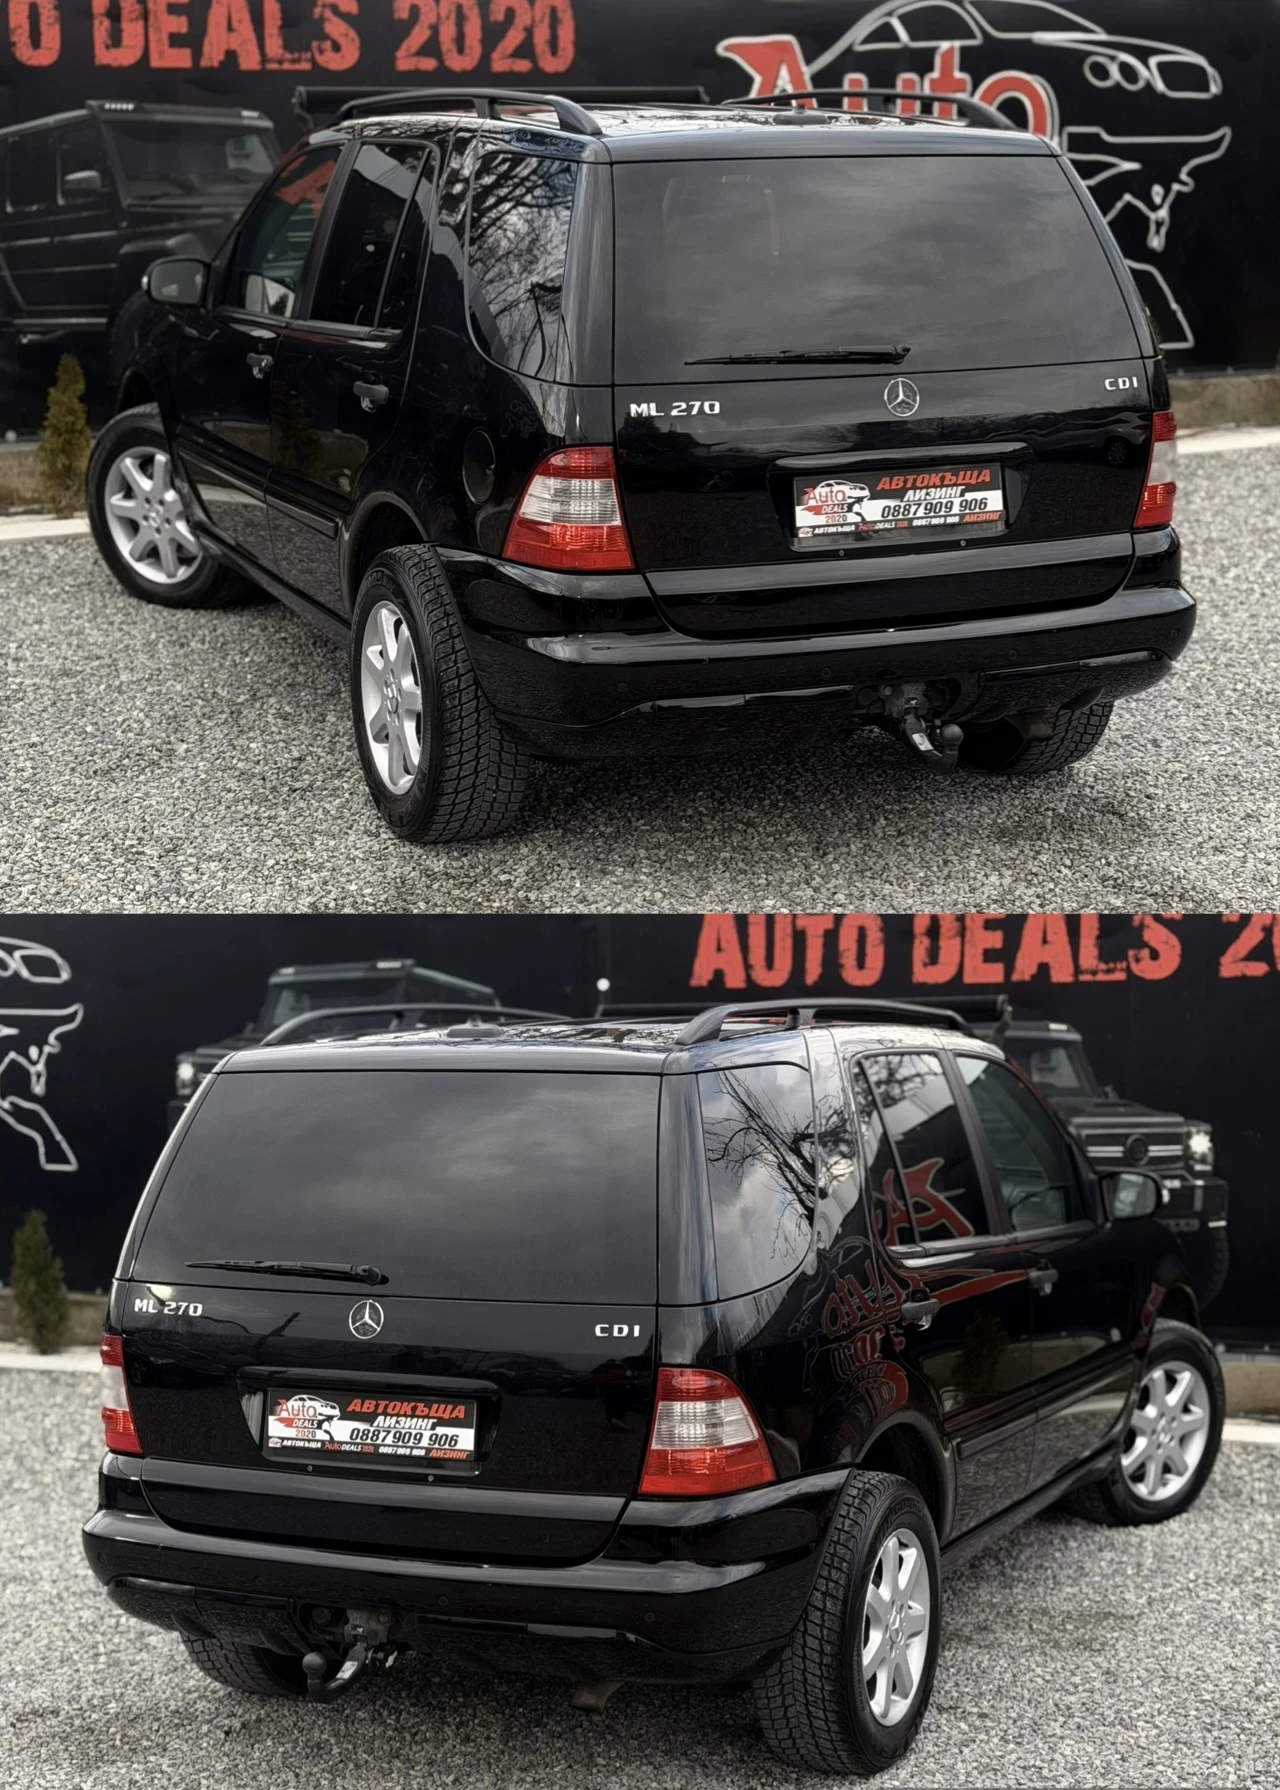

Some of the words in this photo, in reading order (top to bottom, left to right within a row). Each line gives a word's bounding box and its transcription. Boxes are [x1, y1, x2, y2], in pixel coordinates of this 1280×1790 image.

[95, 0, 361, 71] DEALS
[394, 0, 576, 74] 2020
[1104, 376, 1138, 390] CDI
[630, 402, 665, 418] ML
[670, 400, 720, 416] 270
[875, 468, 991, 491] АВТОКЪЩА
[803, 487, 848, 504] Auto
[902, 486, 966, 502] ЛИЗИНГ
[821, 504, 848, 513] DEALS
[959, 497, 988, 512] 906
[825, 514, 847, 523] 2020
[963, 512, 1002, 522] ЛИЗИНГ
[690, 914, 885, 989] AUTO
[911, 914, 1183, 984] DEALS
[134, 1298, 159, 1313] ML
[163, 1301, 203, 1316] 270
[595, 1323, 640, 1337] CDI
[276, 1399, 318, 1418] Auto
[346, 1398, 466, 1419] АВТОКЪЩА
[292, 1419, 318, 1429] DEALS
[372, 1415, 437, 1431] ЛИЗИНГ
[295, 1429, 316, 1438] 2020
[427, 1433, 460, 1447] 906
[429, 1449, 470, 1459] ЛИЗИНГ
